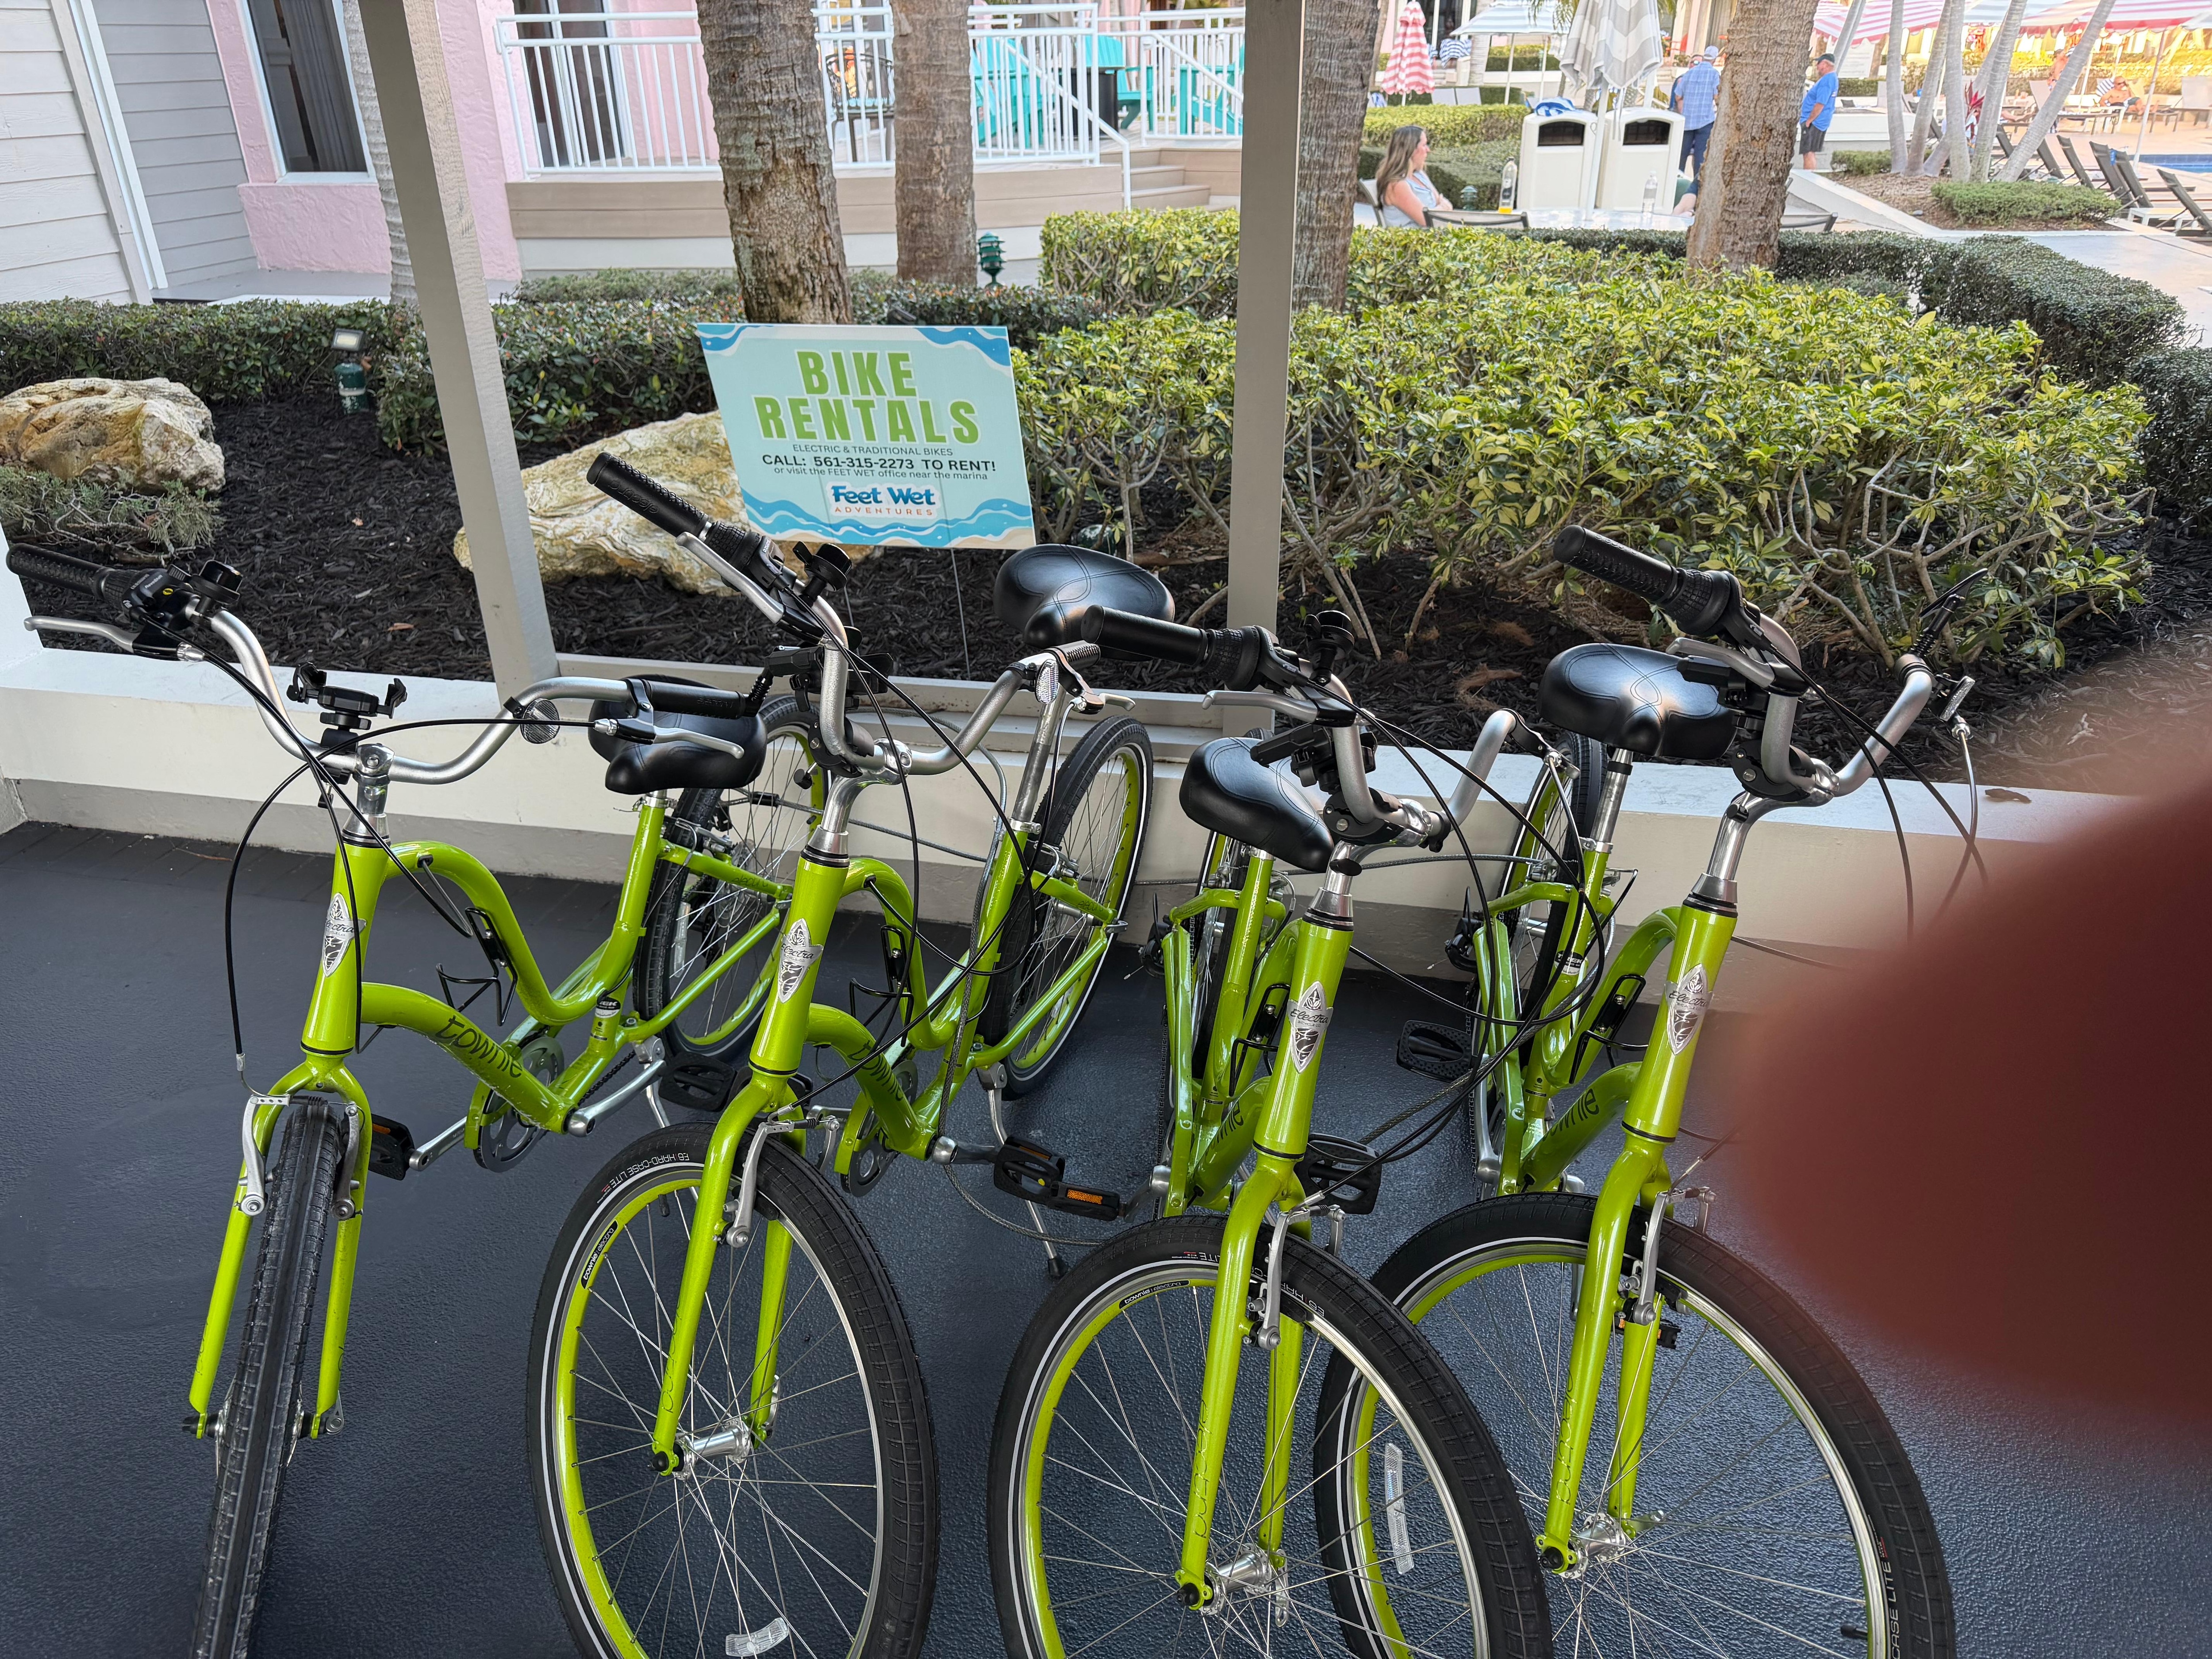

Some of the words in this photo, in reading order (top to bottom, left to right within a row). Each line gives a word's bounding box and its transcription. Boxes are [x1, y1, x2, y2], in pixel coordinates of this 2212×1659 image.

[796, 351, 917, 397] BIKE
[753, 396, 980, 444] RENTALS
[793, 444, 841, 453] ELECTRIC
[852, 446, 921, 455] TRADITIONAL
[762, 454, 806, 466] CALL:
[814, 456, 914, 469] 561-315-2273
[921, 459, 943, 470] TO
[949, 460, 996, 471] RENT!
[787, 466, 807, 475] visit
[809, 467, 826, 476] the
[953, 472, 987, 480] marina
[831, 485, 883, 504] Feet
[887, 487, 936, 505] Wet
[835, 507, 933, 516] ADVENTURES
[326, 920, 354, 933] lectra
[1290, 1008, 1329, 1024] Electra
[435, 1015, 523, 1078] townie
[627, 1153, 676, 1176] HARD-CASE
[677, 1152, 690, 1161] E6
[609, 1171, 628, 1188] LITE
[583, 1253, 598, 1280] townie
[598, 1228, 614, 1252] electra
[1124, 1289, 1150, 1304] townie
[1153, 1282, 1181, 1291] electra
[1309, 1300, 1325, 1317] E6
[1556, 1370, 1577, 1505] electra
[1193, 1399, 1213, 1539] electra
[1881, 1561, 1897, 1602] LITE
